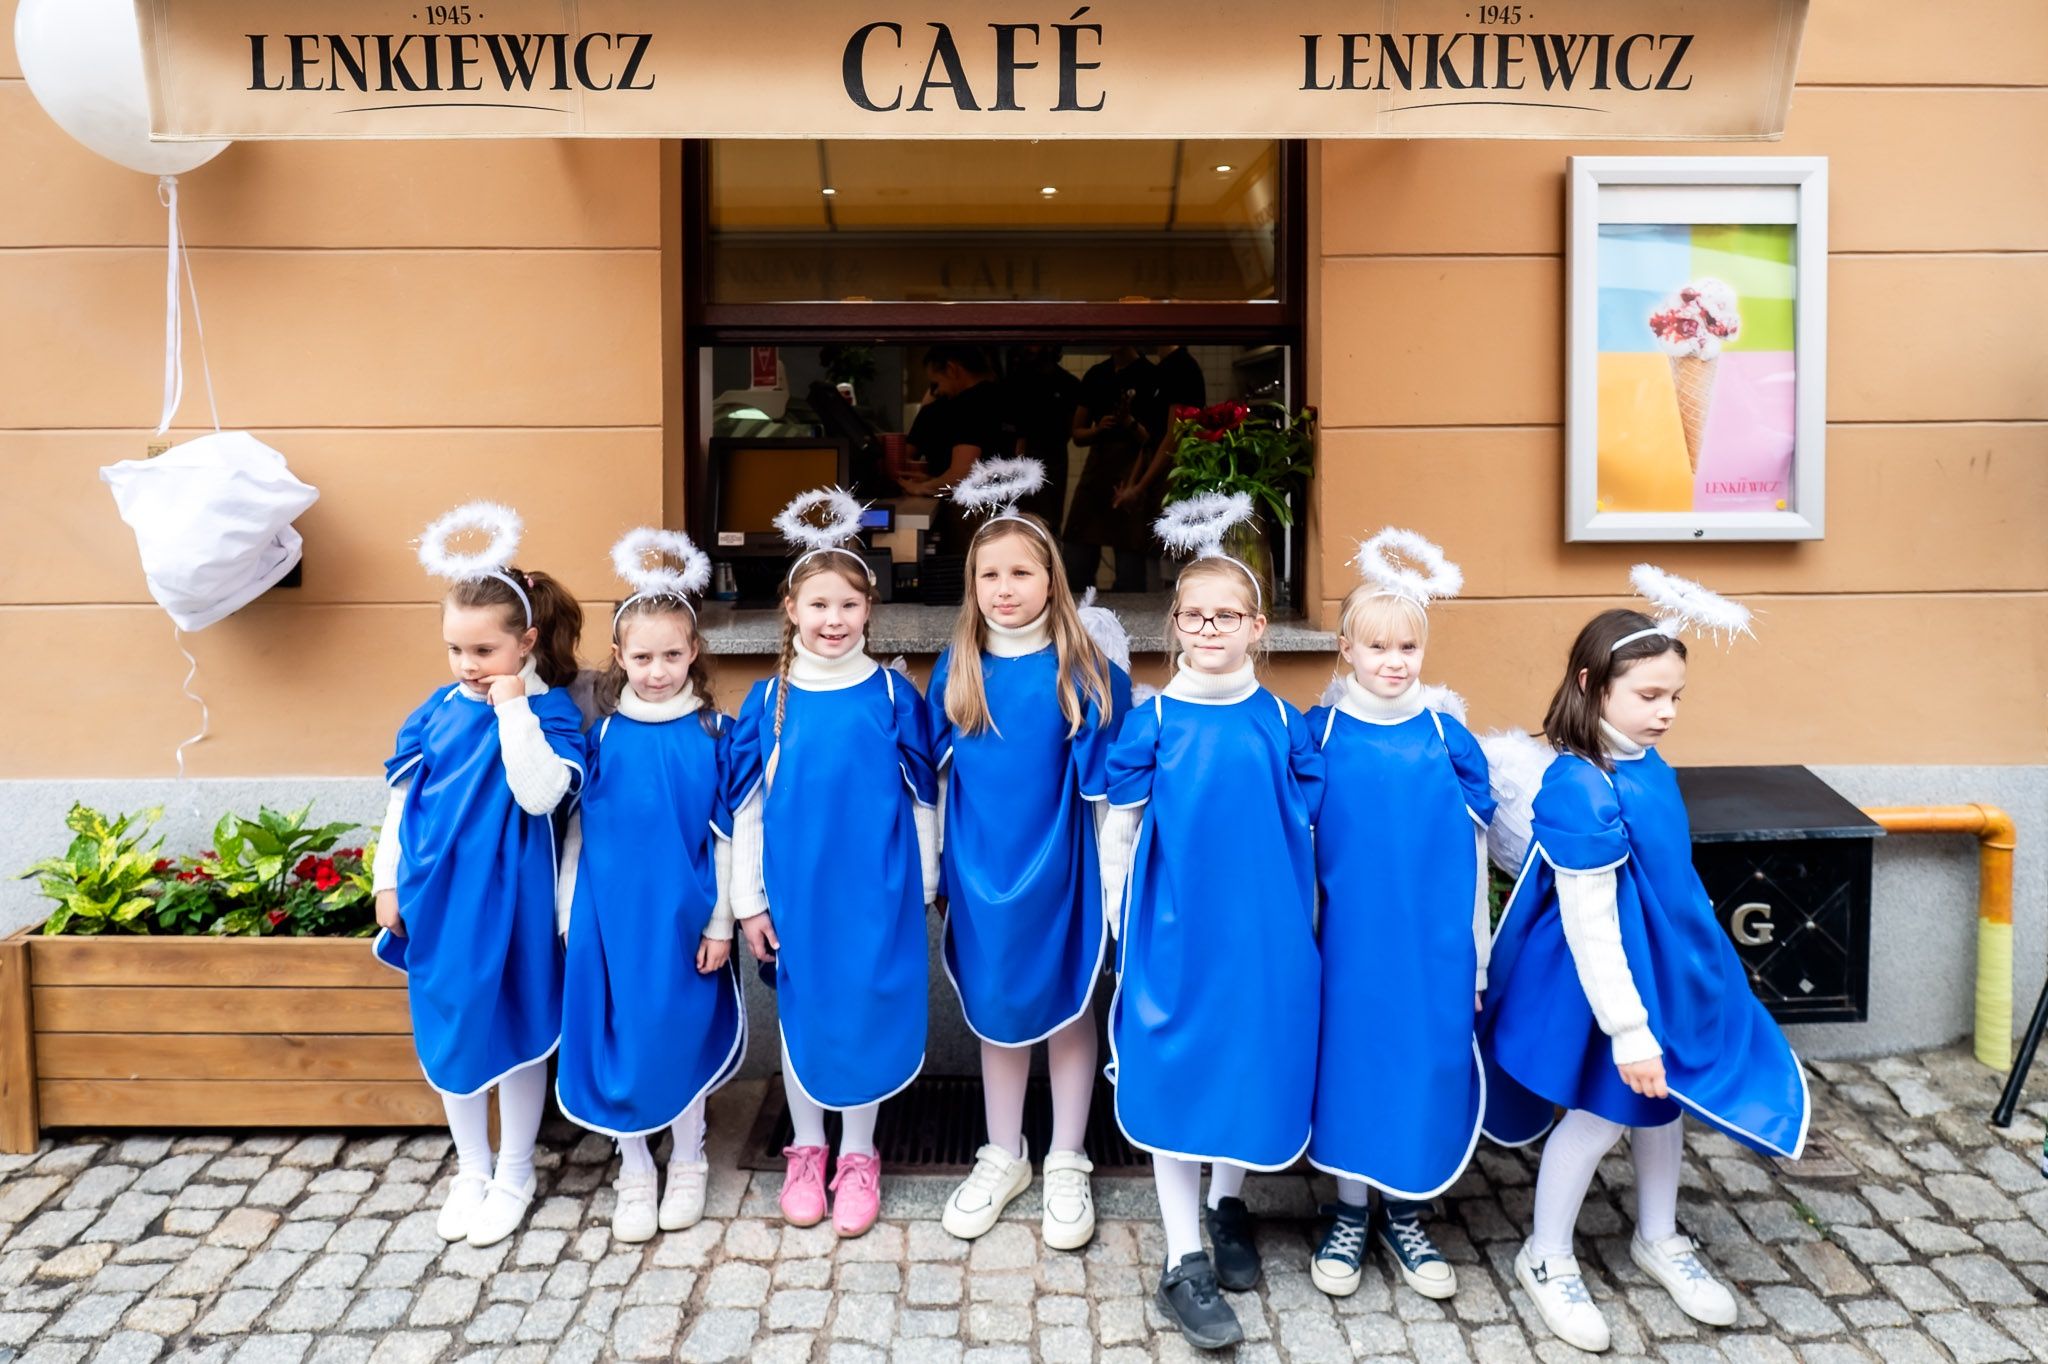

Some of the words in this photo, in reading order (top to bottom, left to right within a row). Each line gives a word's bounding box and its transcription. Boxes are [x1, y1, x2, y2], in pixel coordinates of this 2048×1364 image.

[425, 5, 472, 25] 1945
[1478, 5, 1522, 25] 1945
[245, 32, 656, 92] LENKIEWICZ
[842, 6, 1106, 112] CAFÉ
[1298, 32, 1696, 91] LENKIEWICZ
[1705, 481, 1780, 494] LENKIEWICZ
[1730, 902, 1775, 946] G
